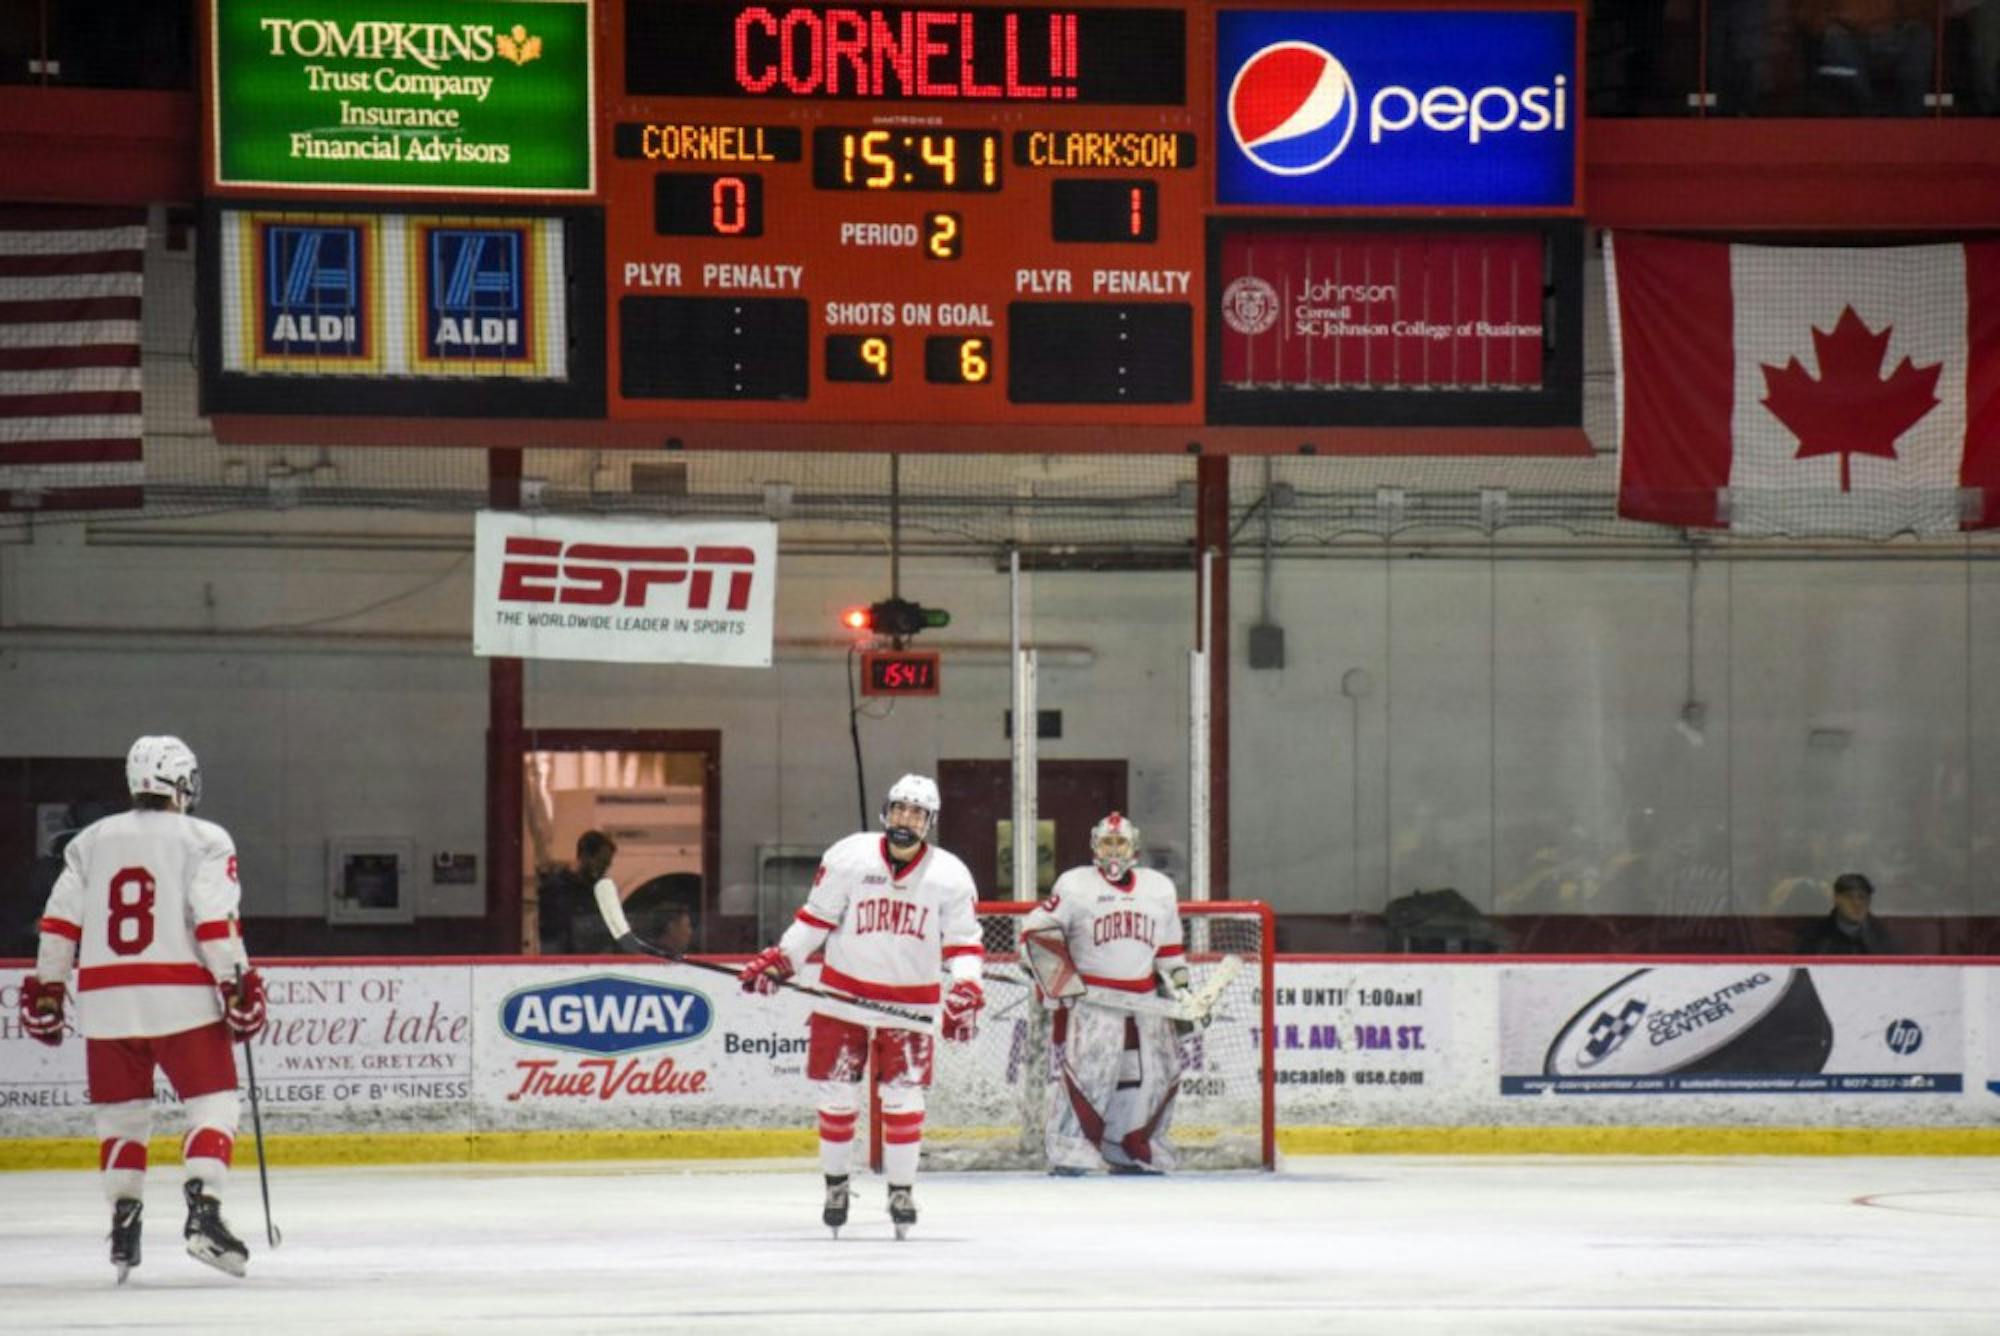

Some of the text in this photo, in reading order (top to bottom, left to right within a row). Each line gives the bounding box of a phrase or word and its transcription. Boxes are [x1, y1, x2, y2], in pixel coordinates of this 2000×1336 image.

[261, 18, 494, 69] TOMPKINS
[735, 7, 1079, 99] CORNELL!!
[305, 66, 493, 100] Trust Company
[340, 101, 460, 127] Insurance
[1370, 74, 1566, 144] pepsi
[290, 133, 511, 163] Financial Advisors
[642, 125, 776, 161] CORNELL
[843, 130, 996, 188] 15:41
[1029, 133, 1178, 167] CLARKSON
[712, 176, 747, 234] 0
[1130, 187, 1142, 237] 1
[840, 223, 919, 247] PERIOD
[930, 214, 954, 257] 2
[624, 263, 803, 290] PLYR PENALTY
[1015, 269, 1191, 295] PLYR PENALTY
[1297, 278, 1397, 303] Johnson
[272, 314, 356, 341] ALDI
[435, 317, 519, 345] ALDI
[825, 302, 993, 327] SHOTS ON GOAL
[1296, 321, 1321, 336] SC
[1323, 320, 1389, 338] Johnson
[1392, 321, 1452, 341] College
[1457, 321, 1473, 337] of
[862, 337, 888, 377] 9
[961, 340, 988, 381] 6
[498, 536, 755, 611] ESPN
[496, 610, 745, 636] THE WORLDWIDE LEADER IN SPORTS
[108, 866, 155, 956] 8
[264, 978, 404, 1004] CENT OF
[1252, 987, 1297, 1006] OEN
[1647, 972, 1772, 1033] COMPUTING
[258, 1000, 468, 1047] never take
[513, 993, 696, 1035] AGWAY
[1649, 1002, 1735, 1047] CENTER
[724, 1032, 809, 1059] Benjam
[1285, 1026, 1305, 1049] N.
[1309, 1025, 1392, 1050] AURA
[1397, 1026, 1427, 1050] ST.
[1890, 1019, 1919, 1055] hp
[361, 1053, 457, 1070] GRETZKY
[333, 1084, 363, 1101] OF
